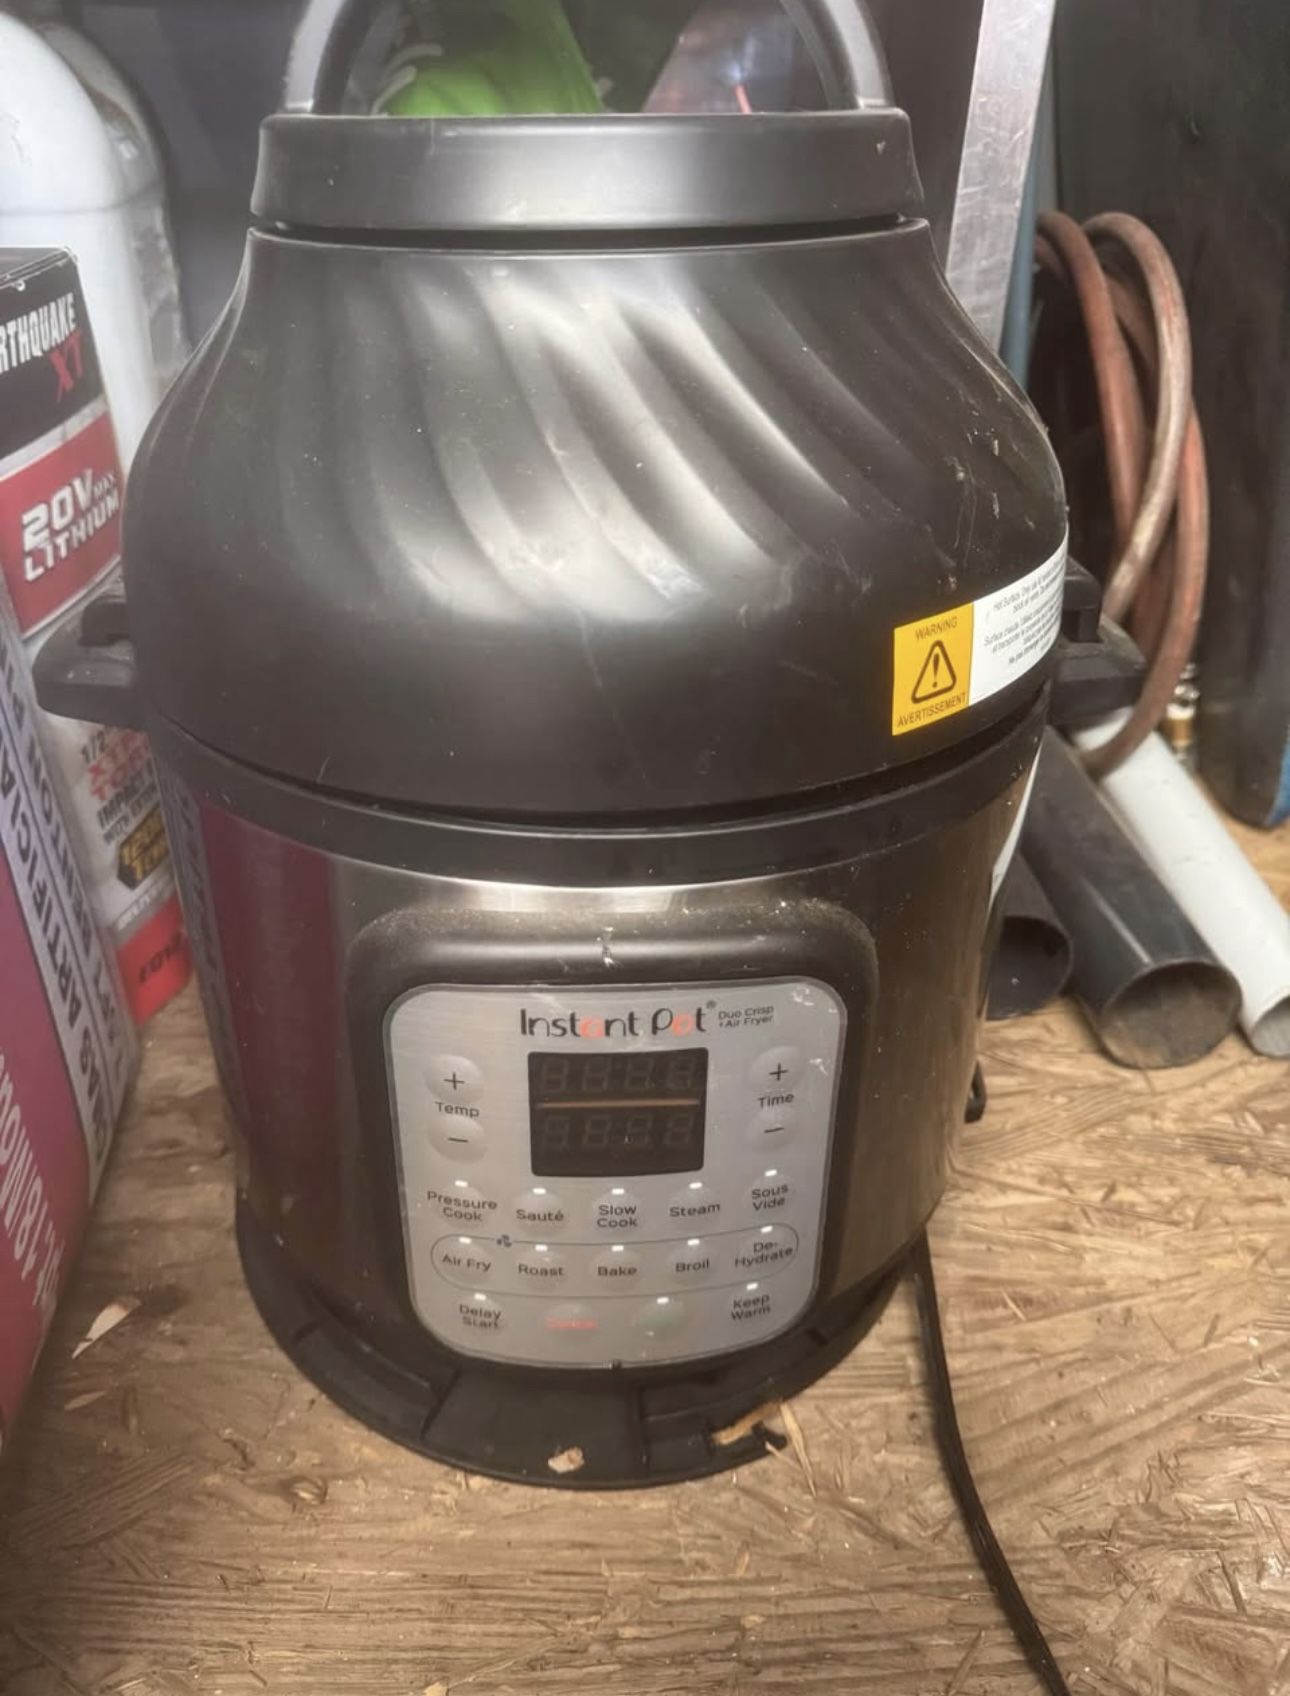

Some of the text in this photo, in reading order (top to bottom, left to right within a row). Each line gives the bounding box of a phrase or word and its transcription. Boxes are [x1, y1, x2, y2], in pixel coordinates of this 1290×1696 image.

[50, 329, 84, 402] XT
[22, 468, 93, 552] 20V
[25, 487, 119, 581] LITHIUM
[915, 616, 958, 641] WARNING
[897, 692, 966, 728] AVERTISSEMENT
[718, 1006, 774, 1020] Duo Crisp
[744, 1015, 773, 1027] Fryer
[520, 1008, 640, 1038] Instant
[757, 1093, 795, 1109] Time
[434, 1101, 480, 1119] Temp
[751, 1183, 789, 1200] Sous
[427, 1190, 498, 1210] Pressure
[752, 1196, 786, 1211] Vide
[442, 1206, 483, 1222] Cook
[516, 1208, 565, 1222] Sauté
[598, 1204, 637, 1217] Slow
[669, 1203, 721, 1218] Steam
[597, 1216, 638, 1228] Cook
[753, 1240, 779, 1253] De-
[442, 1253, 492, 1273] Air Fry
[675, 1257, 710, 1273] Broil
[734, 1246, 794, 1269] Hydrate
[517, 1263, 565, 1277] Roast
[597, 1265, 638, 1277] Bake
[732, 1294, 770, 1310] Keep
[458, 1304, 502, 1321] Delay
[730, 1306, 771, 1321] Warm
[461, 1315, 499, 1329] Start
